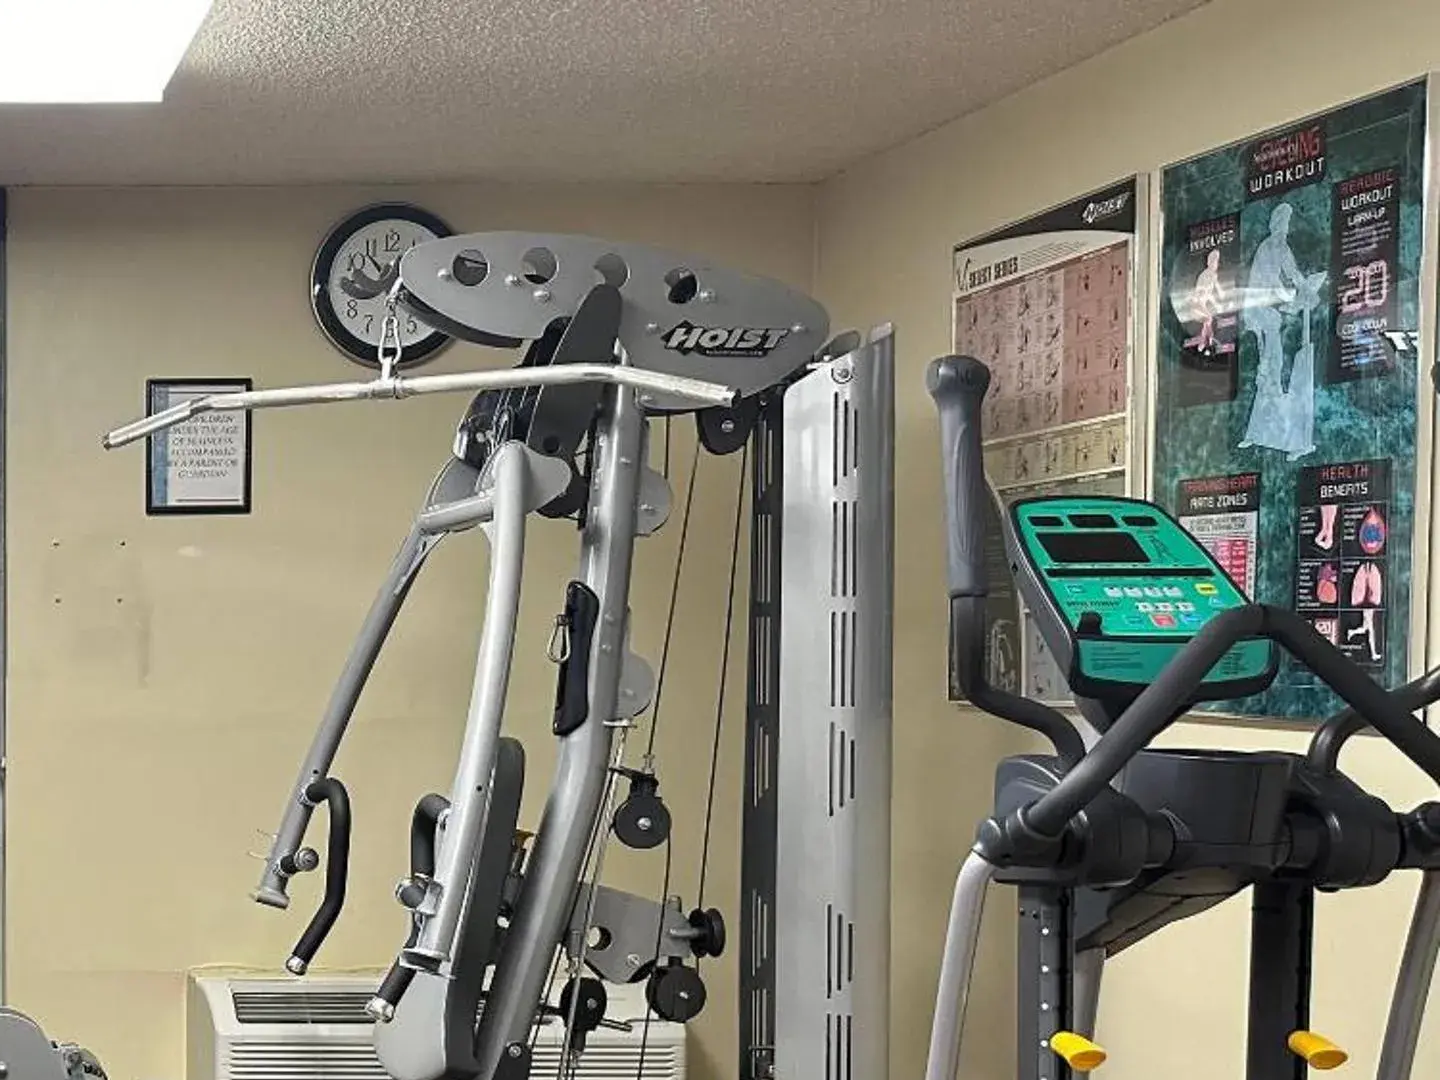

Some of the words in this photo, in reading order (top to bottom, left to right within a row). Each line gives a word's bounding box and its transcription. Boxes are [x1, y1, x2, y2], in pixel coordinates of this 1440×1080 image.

[1250, 157, 1325, 193] WORKOUT
[1341, 184, 1394, 211] WORKOUT
[385, 230, 400, 252] 12
[1189, 230, 1235, 252] INVOLVED
[347, 253, 365, 271] 10
[1339, 260, 1388, 313] 20
[347, 299, 358, 319] 8
[364, 315, 373, 334] 7
[406, 317, 417, 333] 5
[666, 326, 789, 349] HOIST
[1321, 465, 1368, 478] HEALTH
[1320, 482, 1368, 498] BENEFITS
